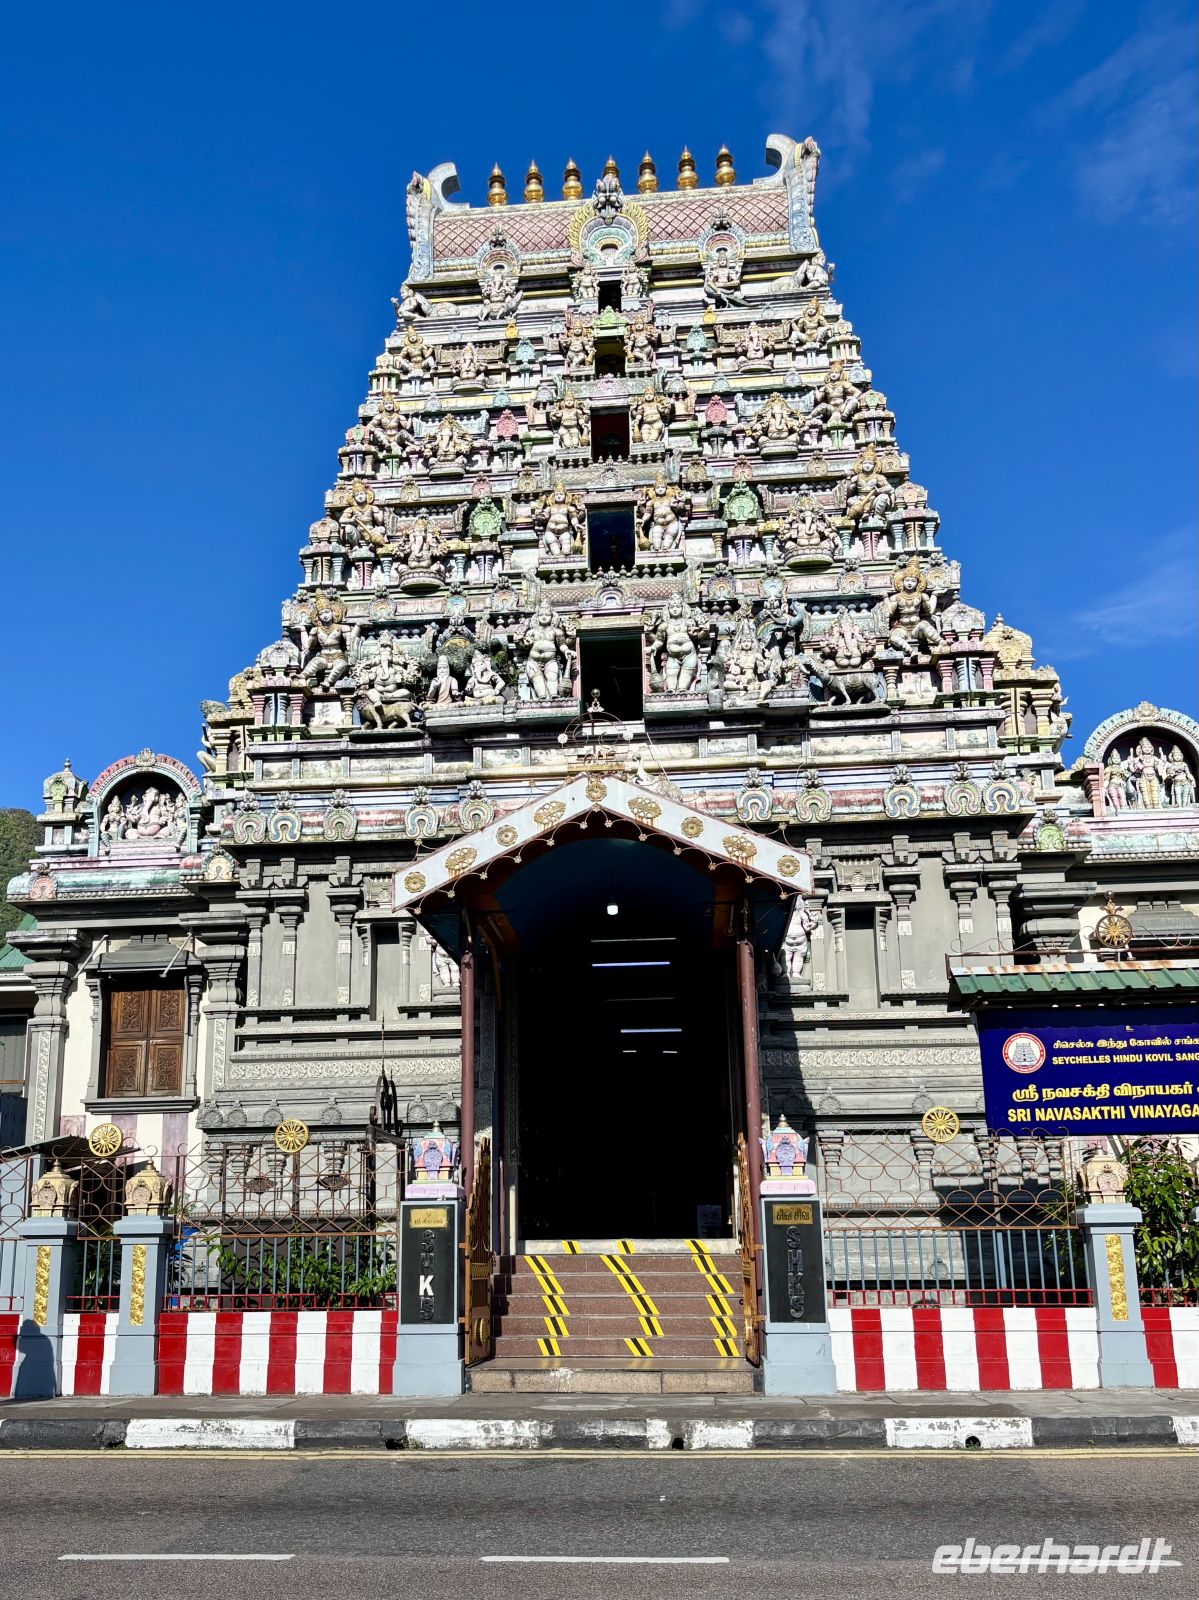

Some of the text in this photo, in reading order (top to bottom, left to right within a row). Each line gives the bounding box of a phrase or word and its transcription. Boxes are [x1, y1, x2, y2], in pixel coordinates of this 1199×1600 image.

[1096, 1038, 1128, 1050] இந்து
[1129, 1036, 1172, 1047] கோவில்
[1052, 1052, 1199, 1065] SEYCHELLES HINDU KOVIL SANG
[1042, 1083, 1110, 1102] நவசக்தி
[1113, 1081, 1193, 1100] விநாயகர்
[1008, 1108, 1031, 1122] SRI
[1035, 1106, 1126, 1121] NAVASAKTHI
